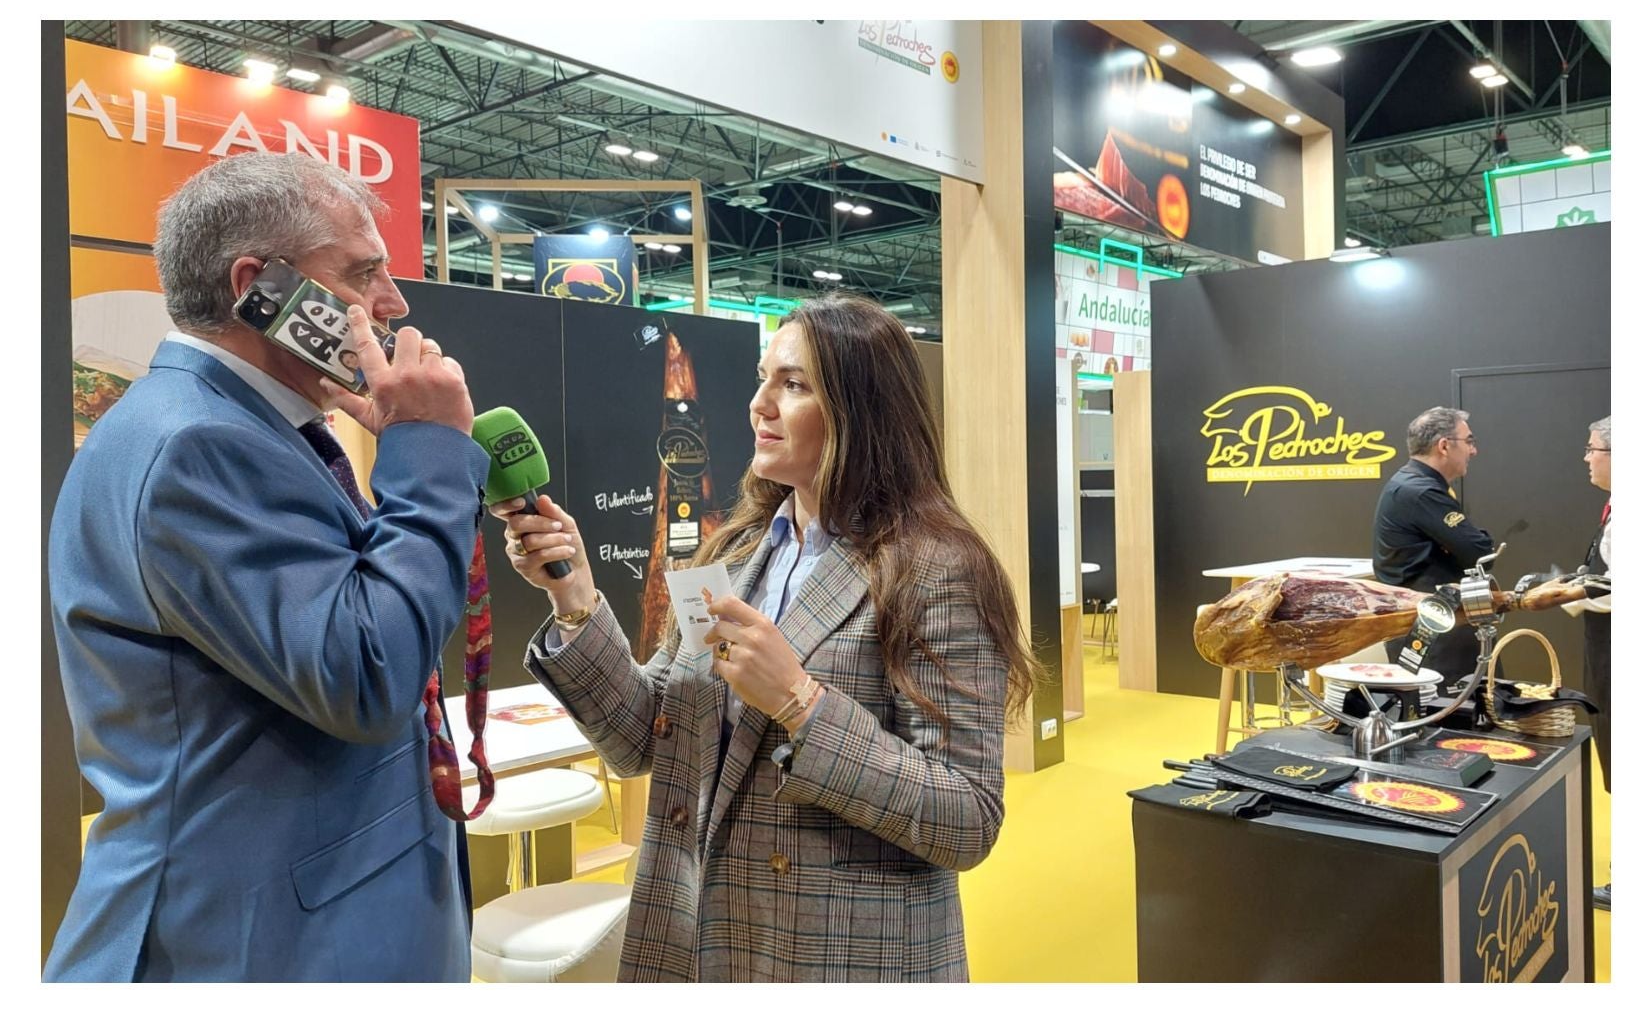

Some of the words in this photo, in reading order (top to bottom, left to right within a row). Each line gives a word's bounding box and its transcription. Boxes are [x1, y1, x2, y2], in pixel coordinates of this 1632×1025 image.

[66, 78, 394, 185] AILAND
[1078, 293, 1150, 327] Andalucía
[504, 444, 530, 460] CERO
[1206, 435, 1249, 467] Los
[1238, 405, 1397, 497] Pedroches
[594, 492, 608, 512] El
[599, 543, 611, 562] El
